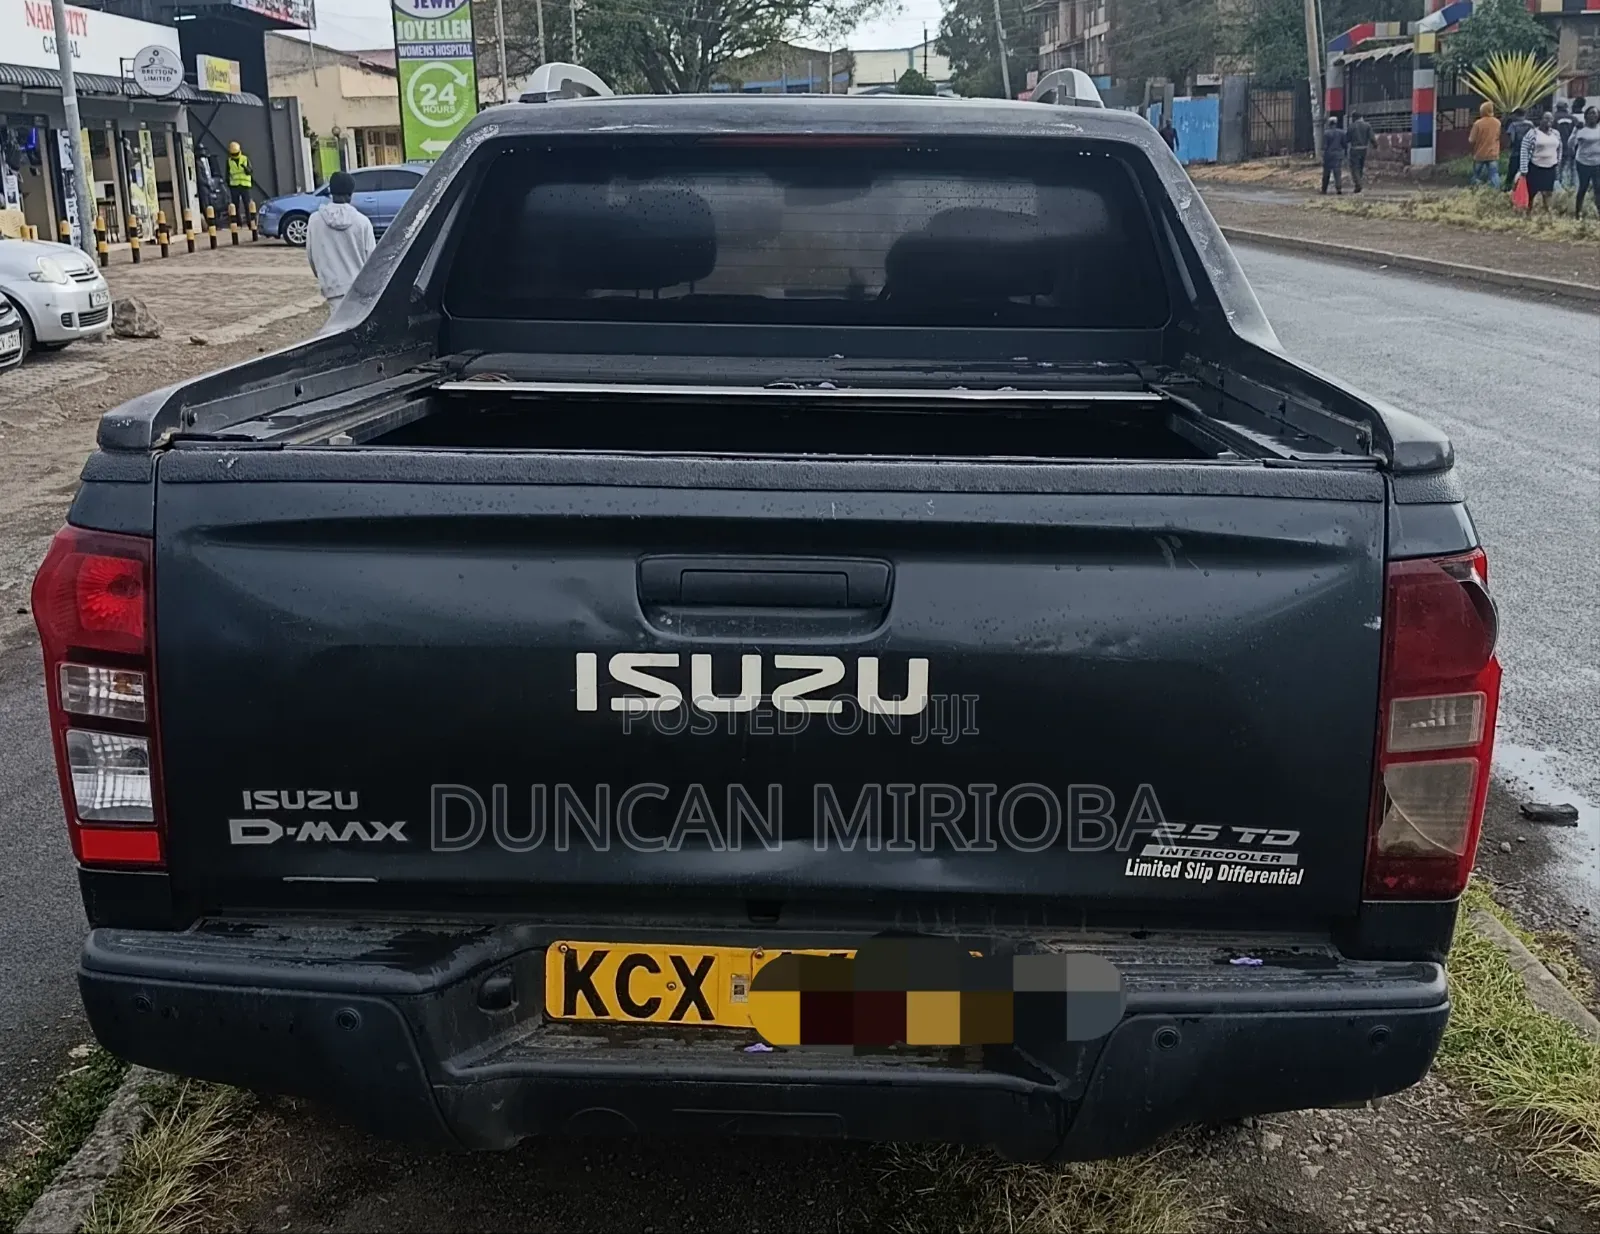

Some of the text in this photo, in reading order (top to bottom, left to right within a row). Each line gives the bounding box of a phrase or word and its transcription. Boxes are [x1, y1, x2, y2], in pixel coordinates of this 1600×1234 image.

[413, 0, 456, 9] JEWH
[397, 19, 472, 41] JOYELLEN
[42, 35, 81, 59] CAAL
[398, 44, 473, 57] WOMENS HOSPITAL
[419, 82, 457, 106] 24
[423, 105, 456, 114] HOURS
[576, 652, 929, 715] ISUZU
[242, 789, 359, 811] ISUZU
[228, 818, 408, 845] D-MAX
[1231, 826, 1300, 846] TD
[1159, 846, 1283, 864] INTERCOOLER
[1125, 858, 1305, 886] Limited Slip Differential
[562, 949, 716, 1022] KCX
